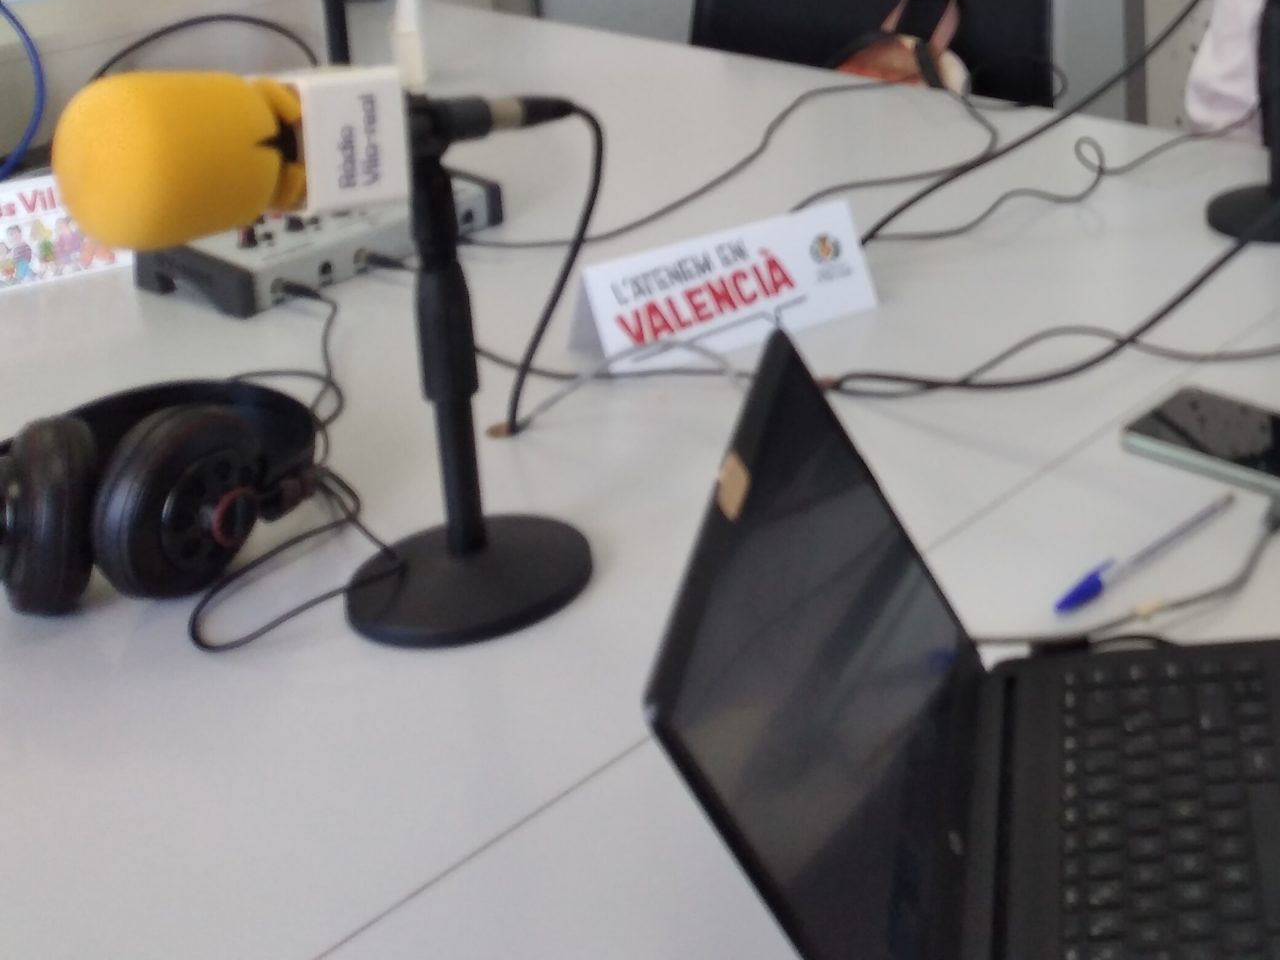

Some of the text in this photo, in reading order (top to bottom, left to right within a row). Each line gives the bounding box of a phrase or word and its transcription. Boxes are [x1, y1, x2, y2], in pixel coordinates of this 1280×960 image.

[358, 93, 380, 187] Vila-real
[17, 186, 60, 214] Vil
[714, 239, 749, 267] EN
[615, 246, 795, 347] VALENCIÀ
